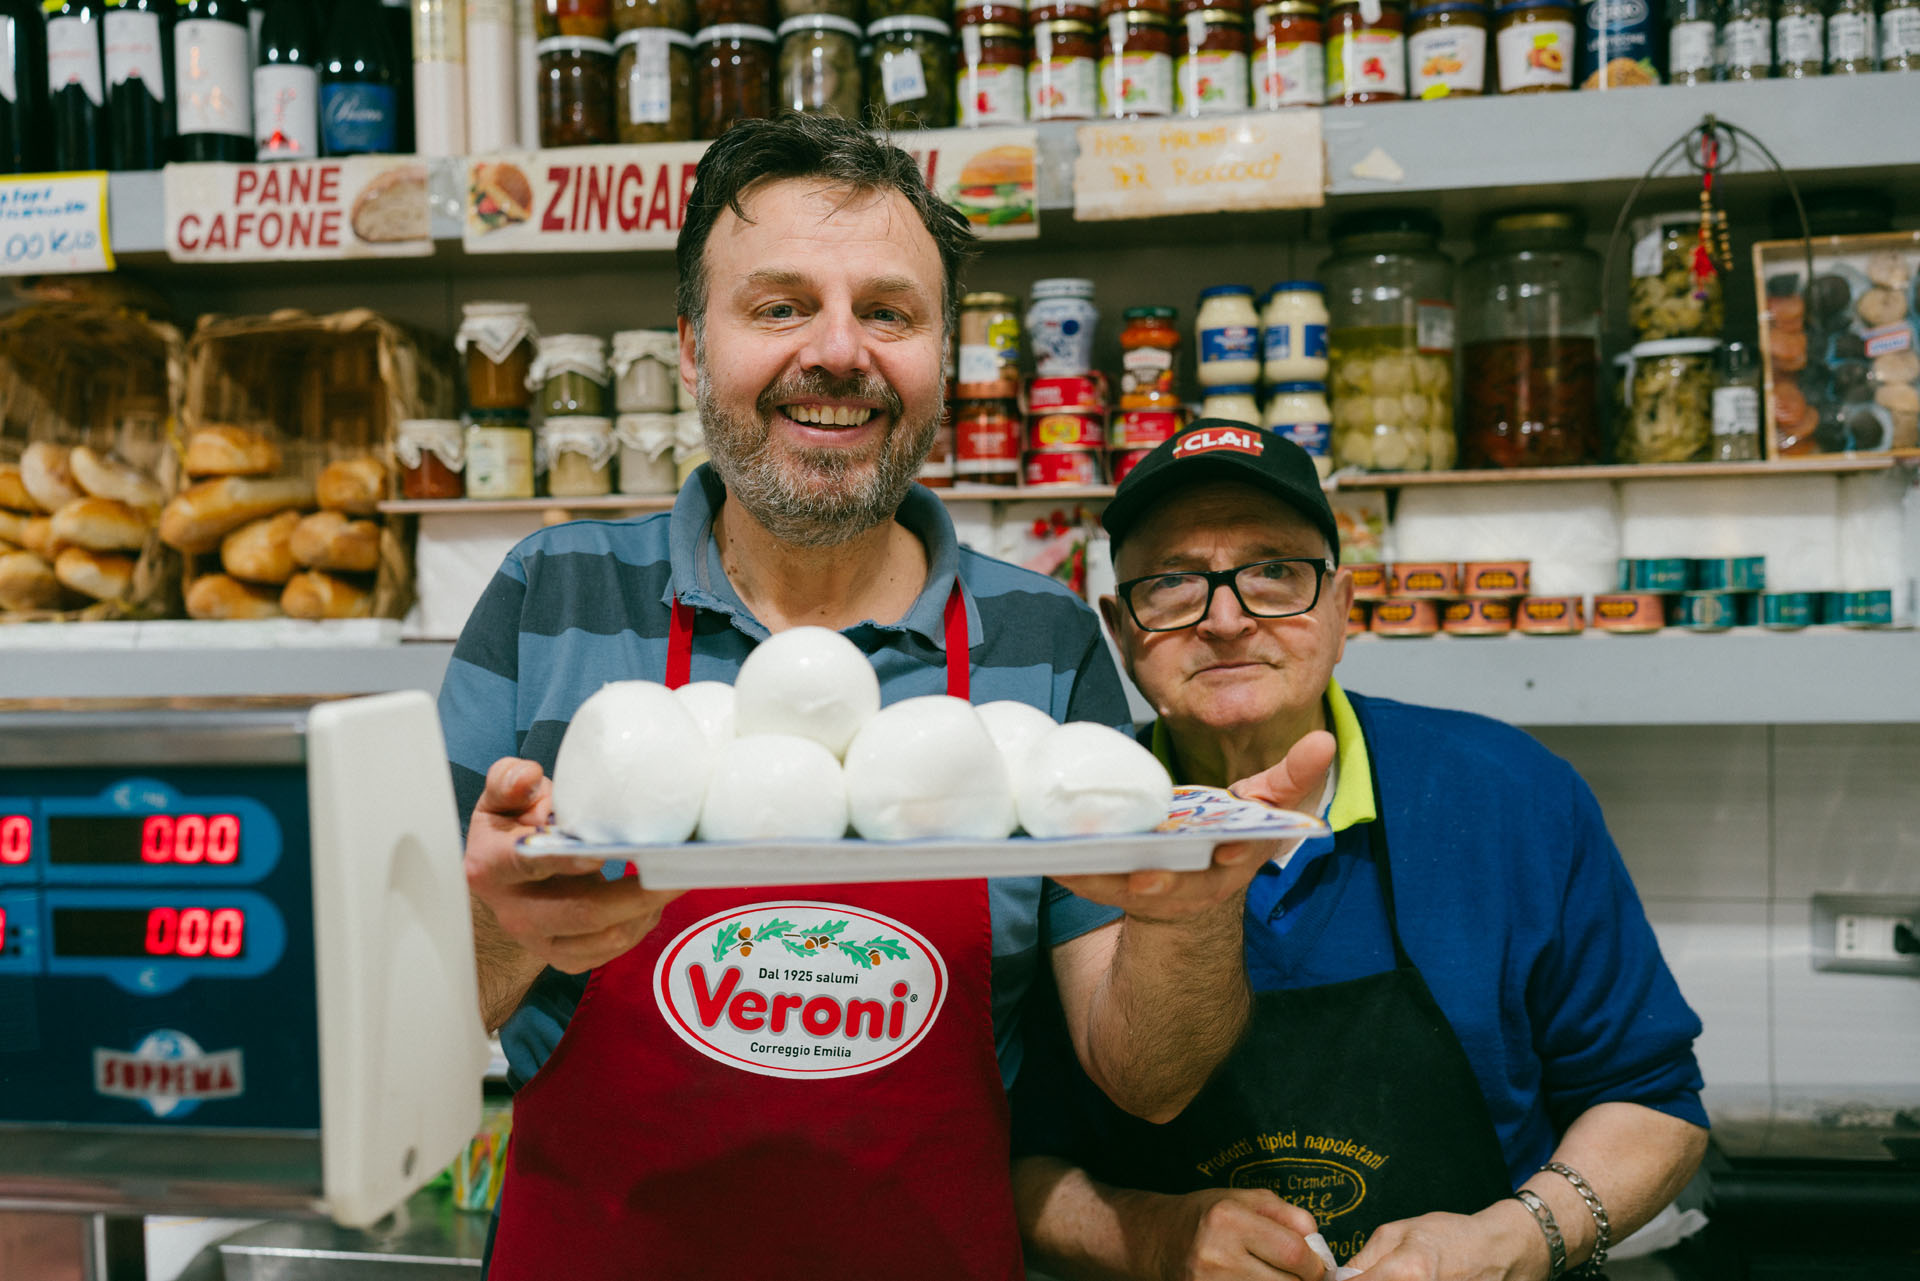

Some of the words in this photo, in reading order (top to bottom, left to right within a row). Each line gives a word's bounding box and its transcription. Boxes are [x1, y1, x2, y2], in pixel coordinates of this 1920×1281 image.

[235, 167, 341, 205] PANE
[541, 163, 698, 232] ZINGAR
[178, 211, 342, 251] CAFONE
[1184, 431, 1250, 451] CLAI
[758, 967, 780, 980] Dal
[784, 969, 813, 982] 1925
[816, 971, 859, 985] salumi
[687, 963, 909, 1041] Veroni
[750, 1042, 811, 1058] Correggio
[814, 1045, 852, 1058] Emilia
[1196, 1137, 1253, 1177] Prodotti
[1256, 1130, 1297, 1154] tipici
[1303, 1134, 1390, 1171] napoletani
[1288, 1170, 1346, 1190] Cremeria
